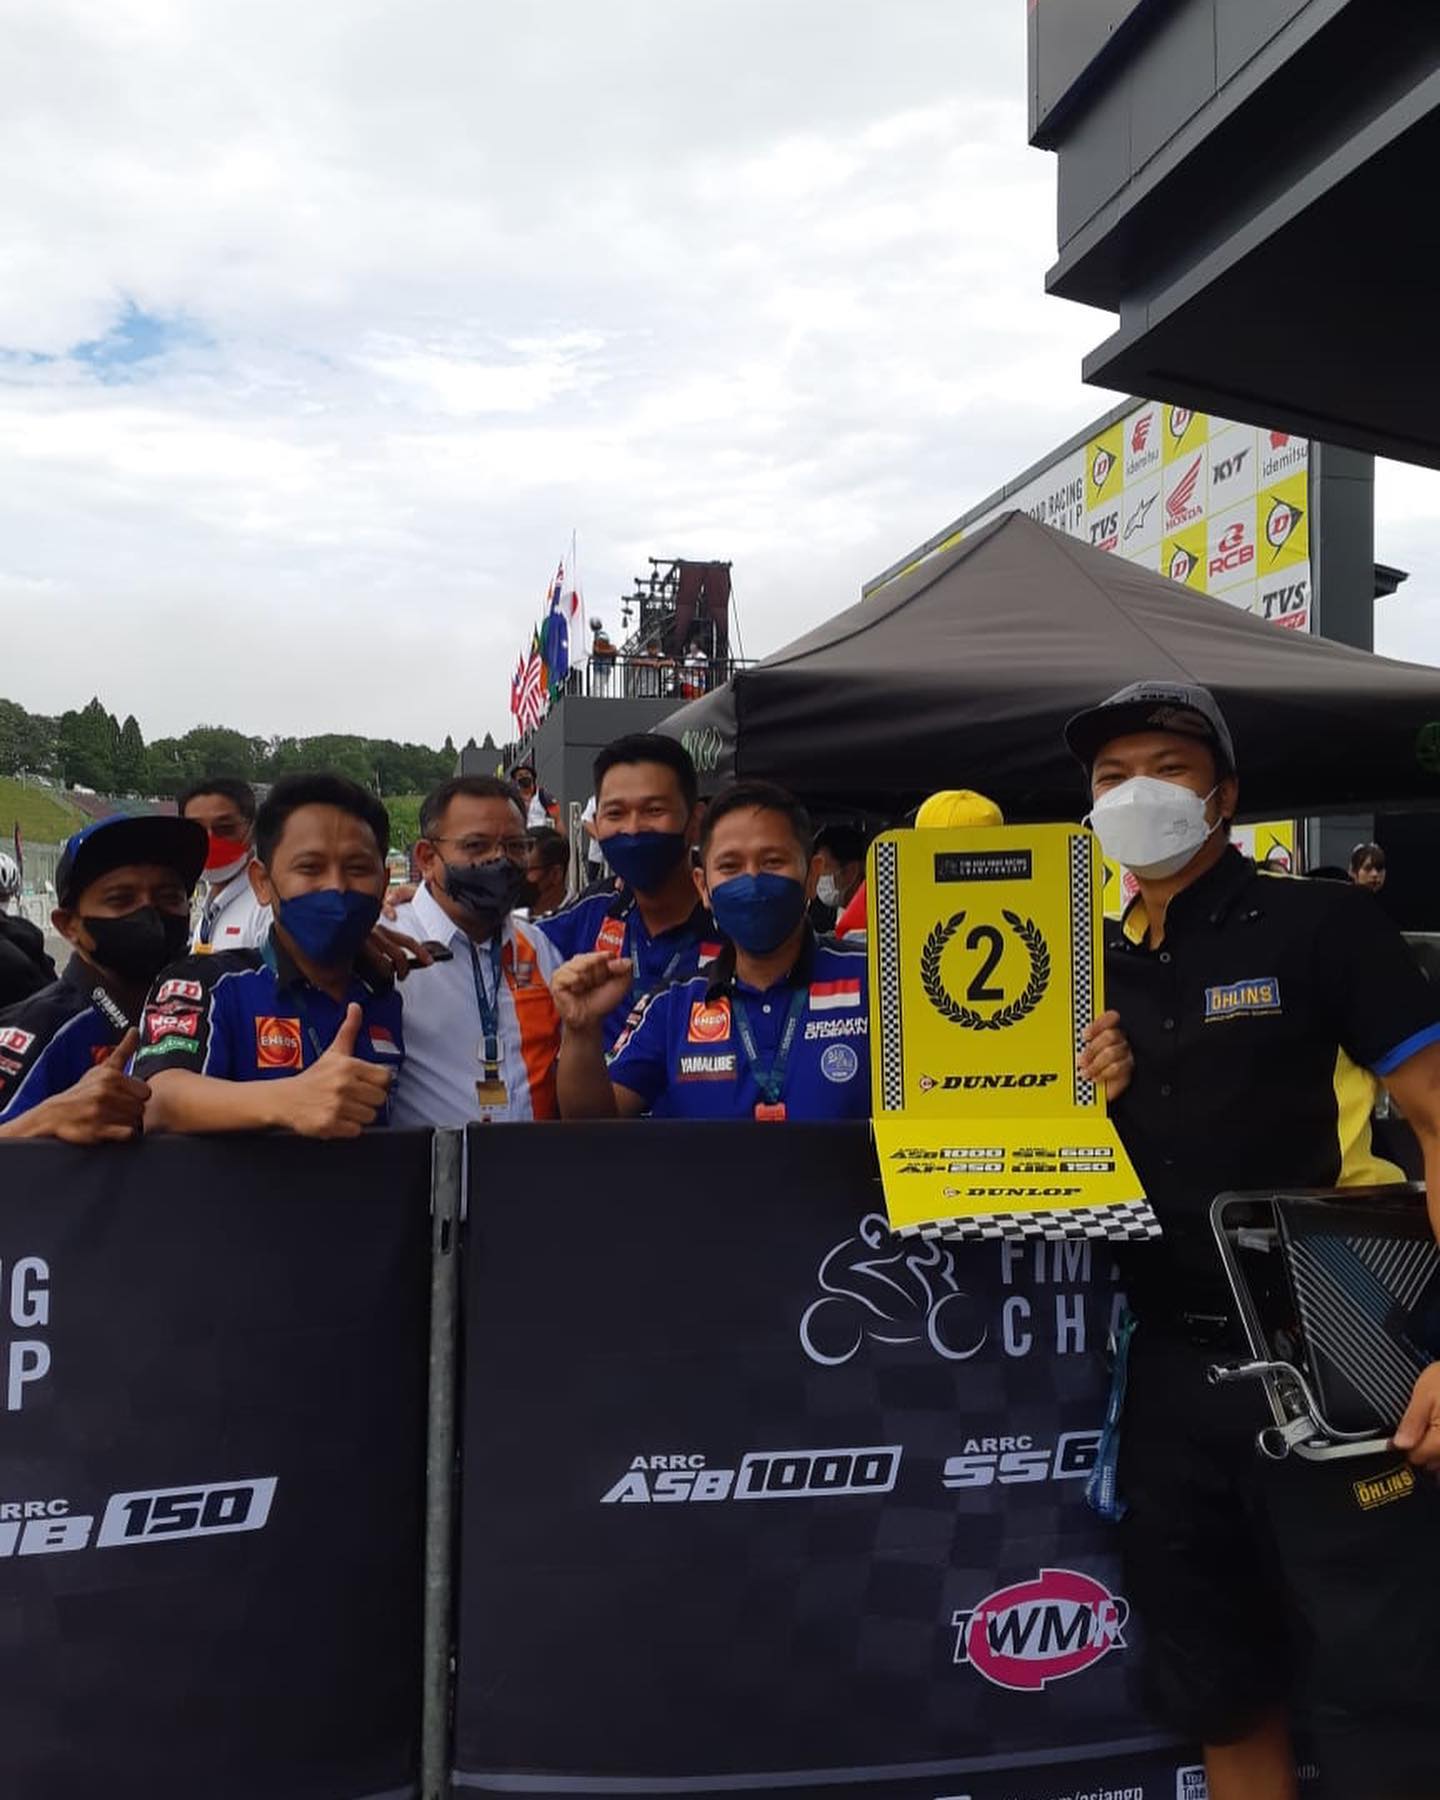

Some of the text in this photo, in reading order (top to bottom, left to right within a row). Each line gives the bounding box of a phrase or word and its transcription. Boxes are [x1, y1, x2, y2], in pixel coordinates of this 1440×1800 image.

[1212, 447, 1252, 485] KYT
[1262, 445, 1308, 478] idemitsu
[1050, 478, 1083, 514] RACING
[1090, 511, 1118, 545] TVS
[1166, 505, 1203, 531] HONDA
[1209, 544, 1254, 578] RCB
[1263, 581, 1306, 619] TVS
[966, 924, 1004, 1001] 2
[151, 1015, 193, 1033] NGK
[261, 1035, 298, 1048] ENEOS
[680, 1055, 735, 1073] YAMALUBE
[940, 1073, 1058, 1089] DUNLOP
[966, 1187, 1081, 1196] DUNLOP
[963, 1435, 1033, 1454] ARRC
[599, 1451, 896, 1503] ASB 1000
[630, 1454, 705, 1469] ARRC
[117, 1482, 262, 1541] 150
